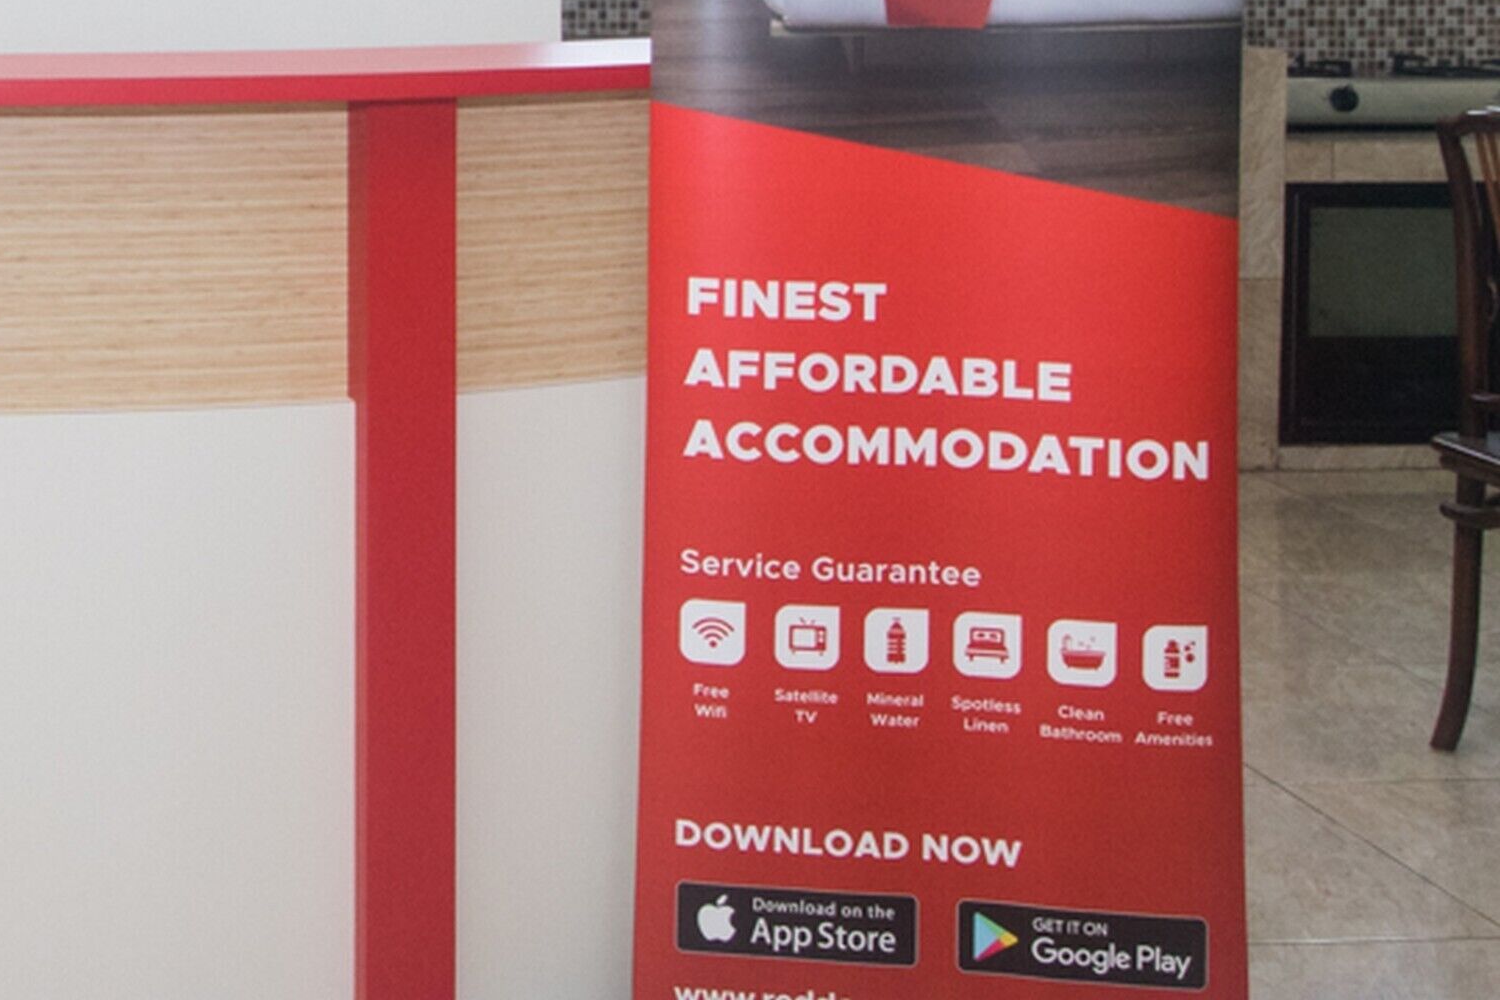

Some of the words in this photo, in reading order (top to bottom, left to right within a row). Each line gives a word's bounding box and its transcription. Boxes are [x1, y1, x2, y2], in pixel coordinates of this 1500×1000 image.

[687, 278, 887, 322] FINEST
[684, 349, 1073, 401] AFFORDABLE
[683, 419, 1209, 480] ACCOMMODATION
[680, 548, 801, 580] Service
[812, 557, 981, 587] Guarantee
[693, 683, 730, 699] Free
[774, 688, 839, 705] Satellite
[866, 693, 924, 707] Mineral
[951, 695, 1022, 715] Spotless
[1058, 705, 1105, 721] Clean
[794, 709, 817, 723] TV
[870, 713, 920, 728] Water
[963, 718, 1009, 733] Linen
[1157, 711, 1194, 726] Free
[1039, 724, 1122, 743] Bathroom
[1135, 731, 1213, 747] Amenities
[674, 819, 910, 861] DOWNLOAD
[922, 834, 1022, 868] NOW
[752, 897, 836, 917] Download
[841, 905, 862, 918] on
[868, 905, 895, 921] the
[750, 917, 812, 953] App
[817, 922, 897, 953] Store
[1032, 917, 1064, 932] GET
[1066, 920, 1081, 934] IT
[1082, 921, 1108, 936] ON
[1031, 937, 1131, 974] Google
[1136, 946, 1191, 979] Play
